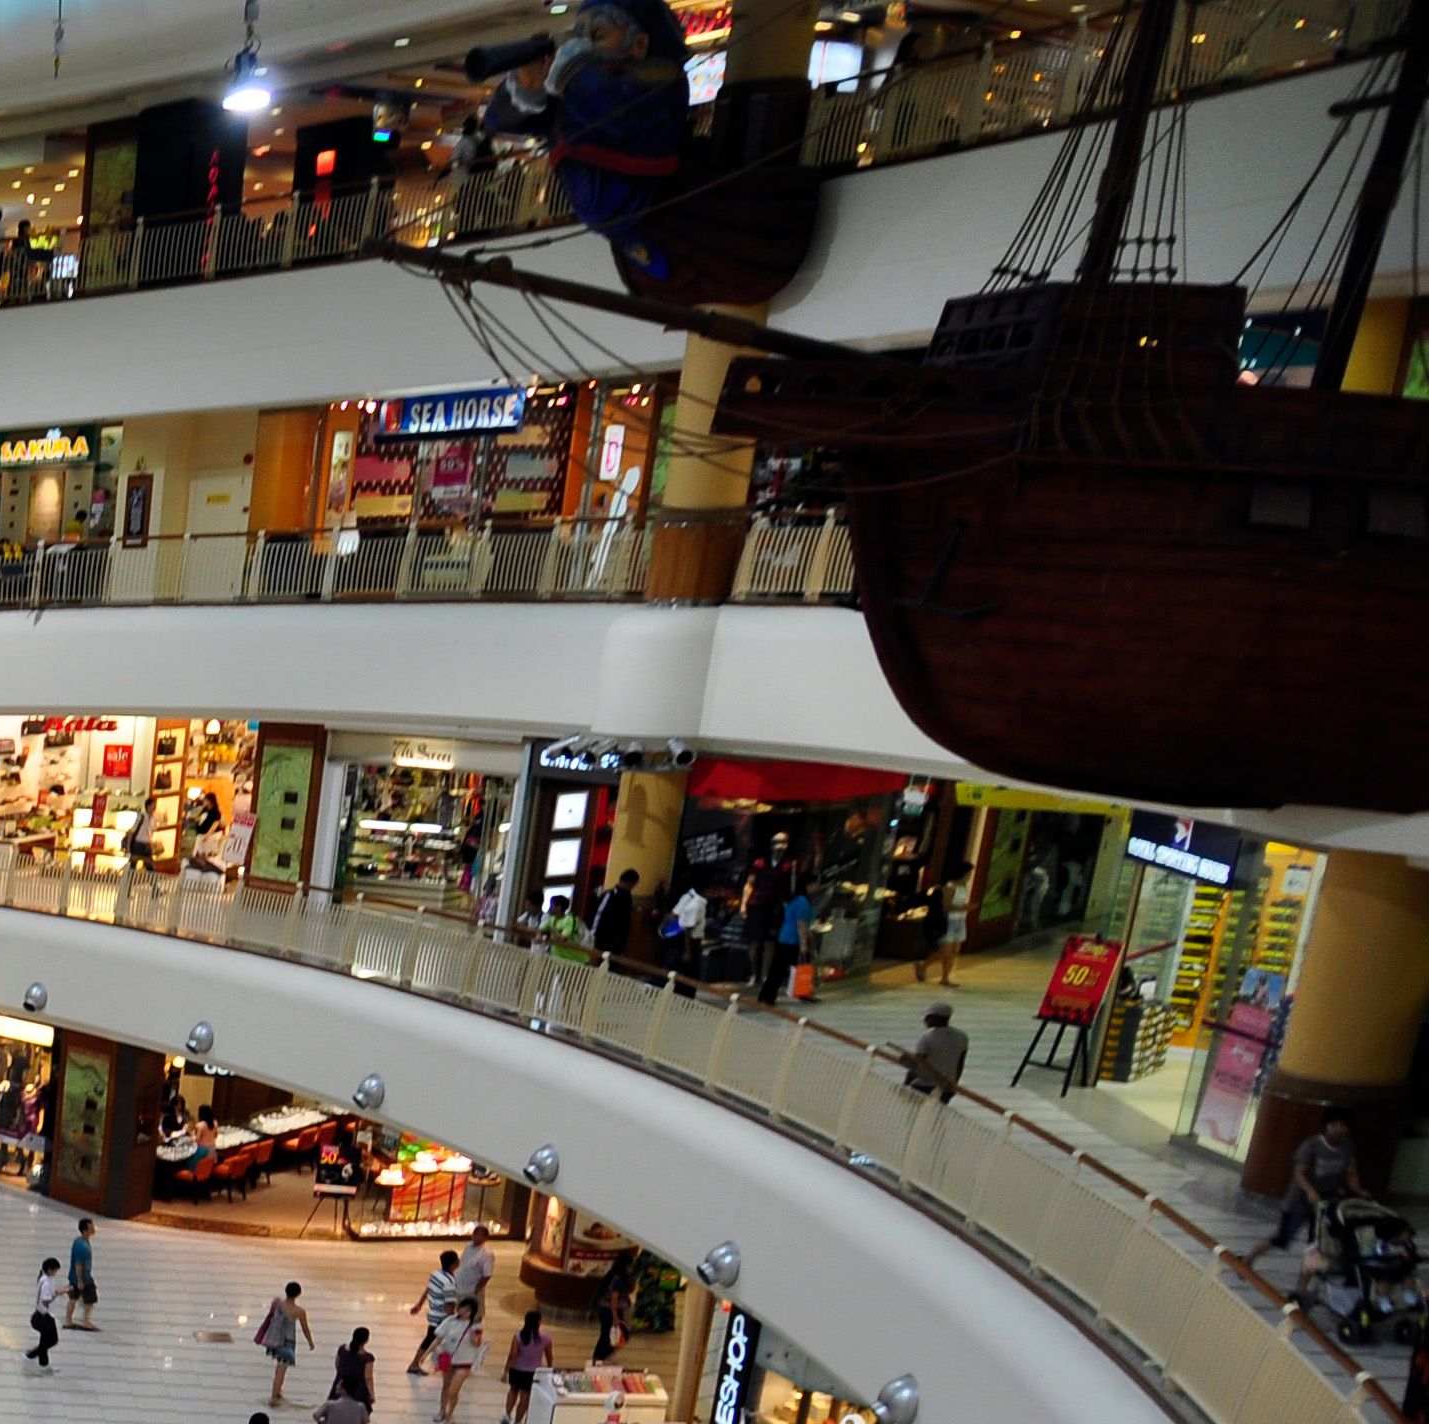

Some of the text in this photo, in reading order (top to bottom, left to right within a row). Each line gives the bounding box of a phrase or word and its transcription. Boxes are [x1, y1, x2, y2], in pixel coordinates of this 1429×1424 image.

[409, 394, 517, 433] SEA HORSE
[0, 436, 88, 462] SAKURA
[1062, 966, 1087, 986] 50
